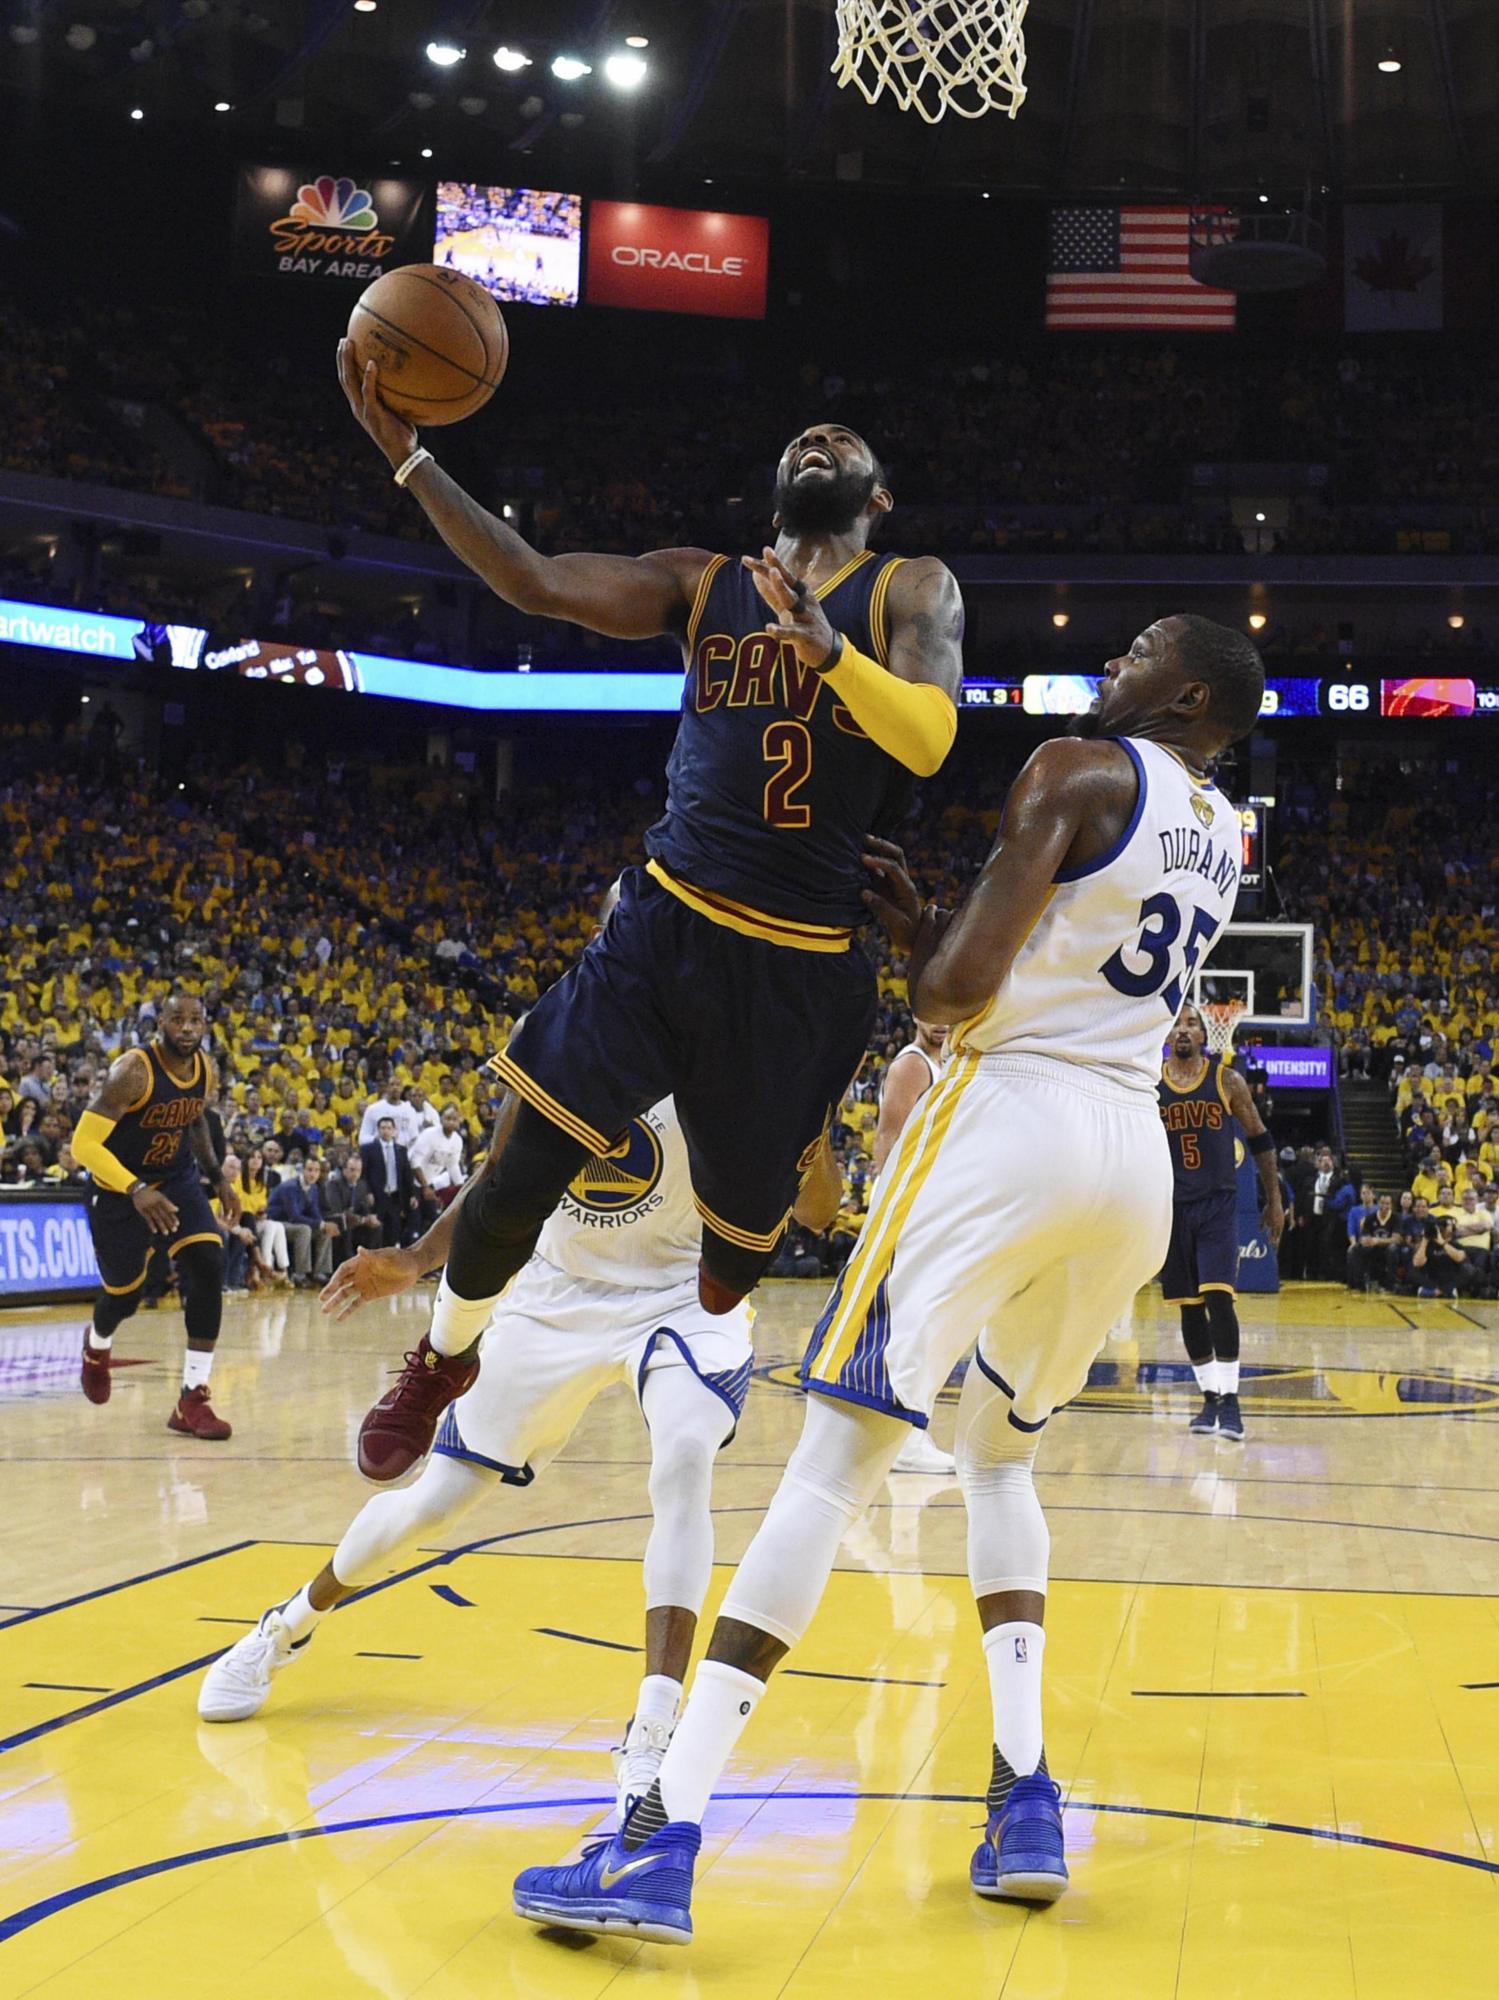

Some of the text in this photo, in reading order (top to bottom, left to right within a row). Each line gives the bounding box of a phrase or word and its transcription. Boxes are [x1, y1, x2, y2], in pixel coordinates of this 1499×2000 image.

[270, 215, 394, 257] Sports
[279, 256, 382, 278] BAY AREA
[611, 246, 742, 275] ORACLE
[965, 688, 1021, 705] TOL 3 1
[1328, 684, 1370, 710] 66
[762, 720, 811, 828] 2
[1159, 827, 1238, 898] DURANT
[1098, 892, 1221, 1017] 35
[1265, 1060, 1327, 1076] INTENSITY!
[1180, 1134, 1200, 1169] 5
